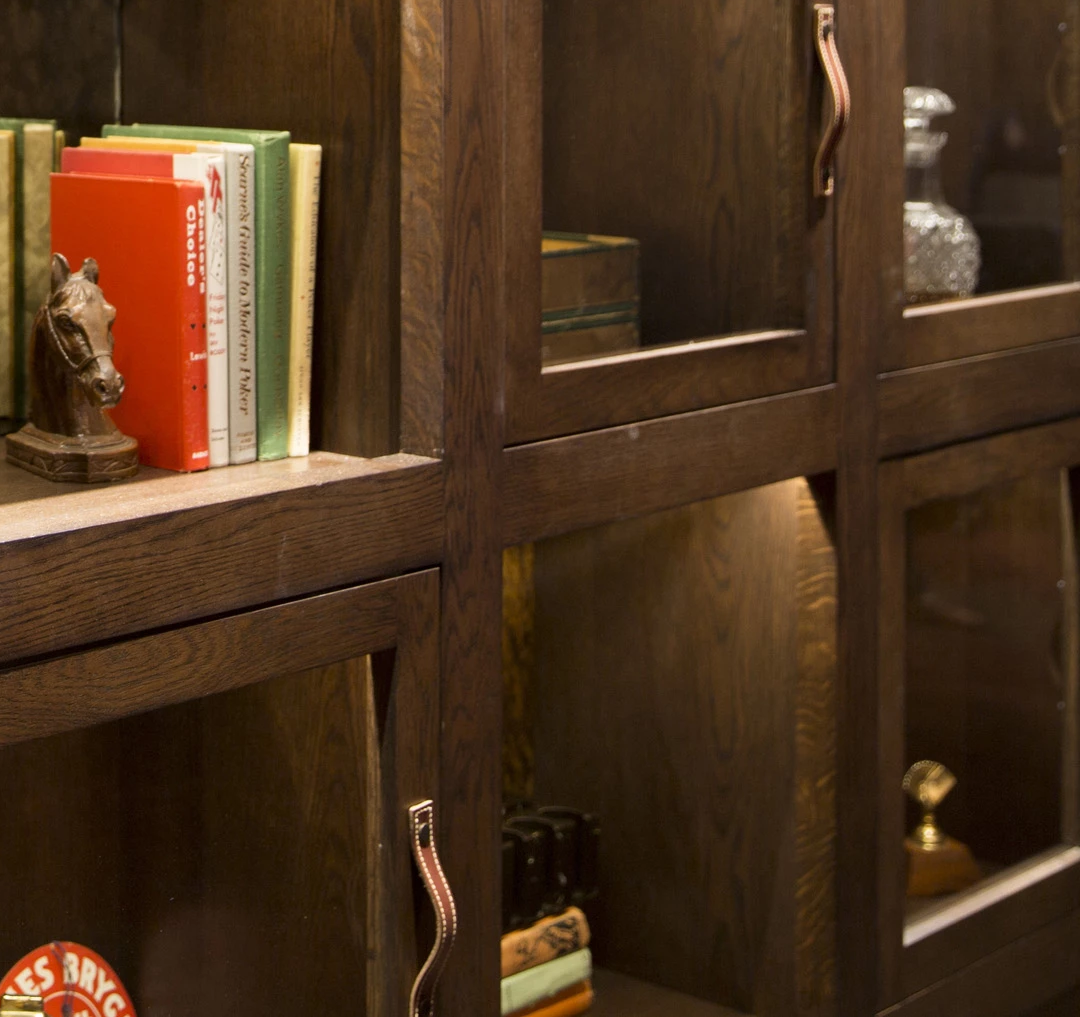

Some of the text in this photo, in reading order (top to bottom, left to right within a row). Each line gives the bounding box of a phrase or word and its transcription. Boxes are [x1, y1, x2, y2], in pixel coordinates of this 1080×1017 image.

[185, 204, 197, 287] Choice
[239, 153, 252, 416] Scarne's Guide to Modern Poker
